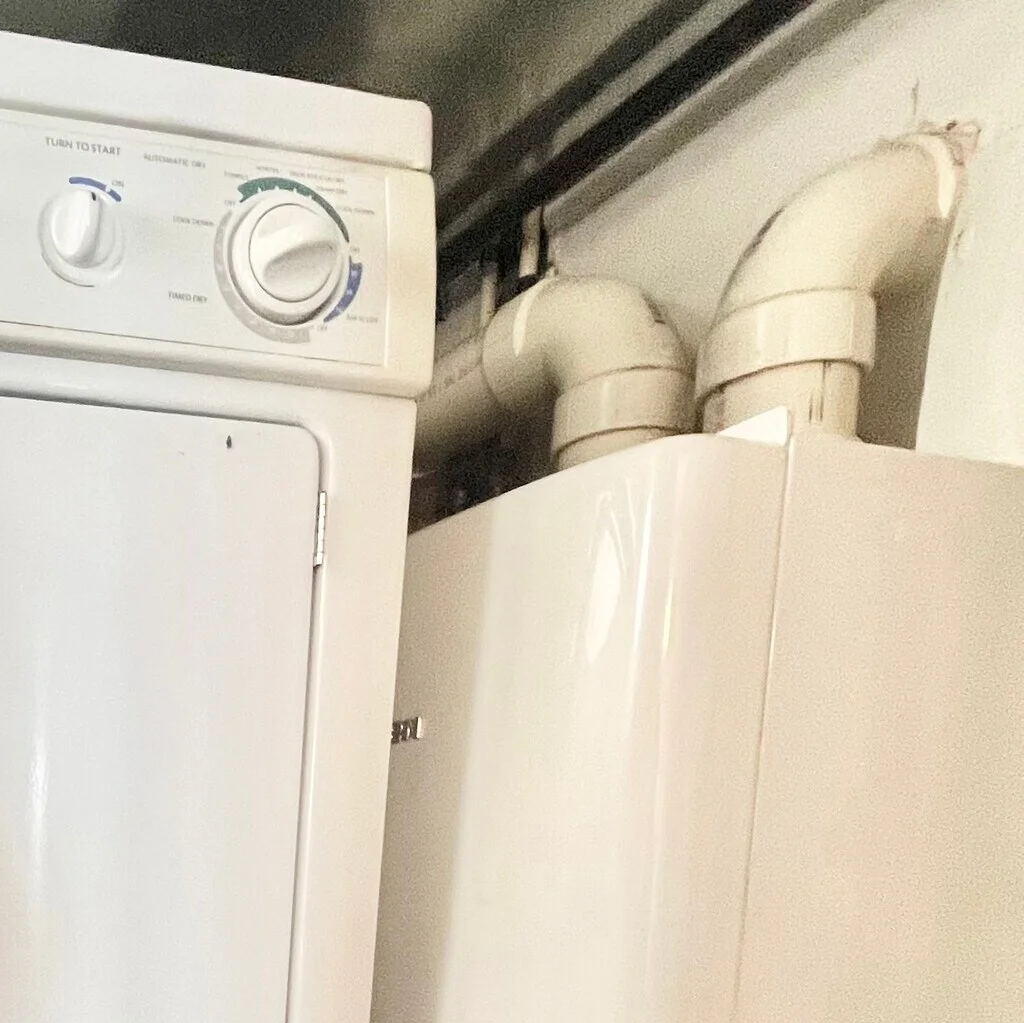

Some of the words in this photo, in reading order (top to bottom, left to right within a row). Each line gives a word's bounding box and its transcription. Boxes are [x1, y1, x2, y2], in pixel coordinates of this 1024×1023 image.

[45, 136, 73, 150] TURN
[75, 140, 90, 152] TO
[91, 142, 121, 157] START
